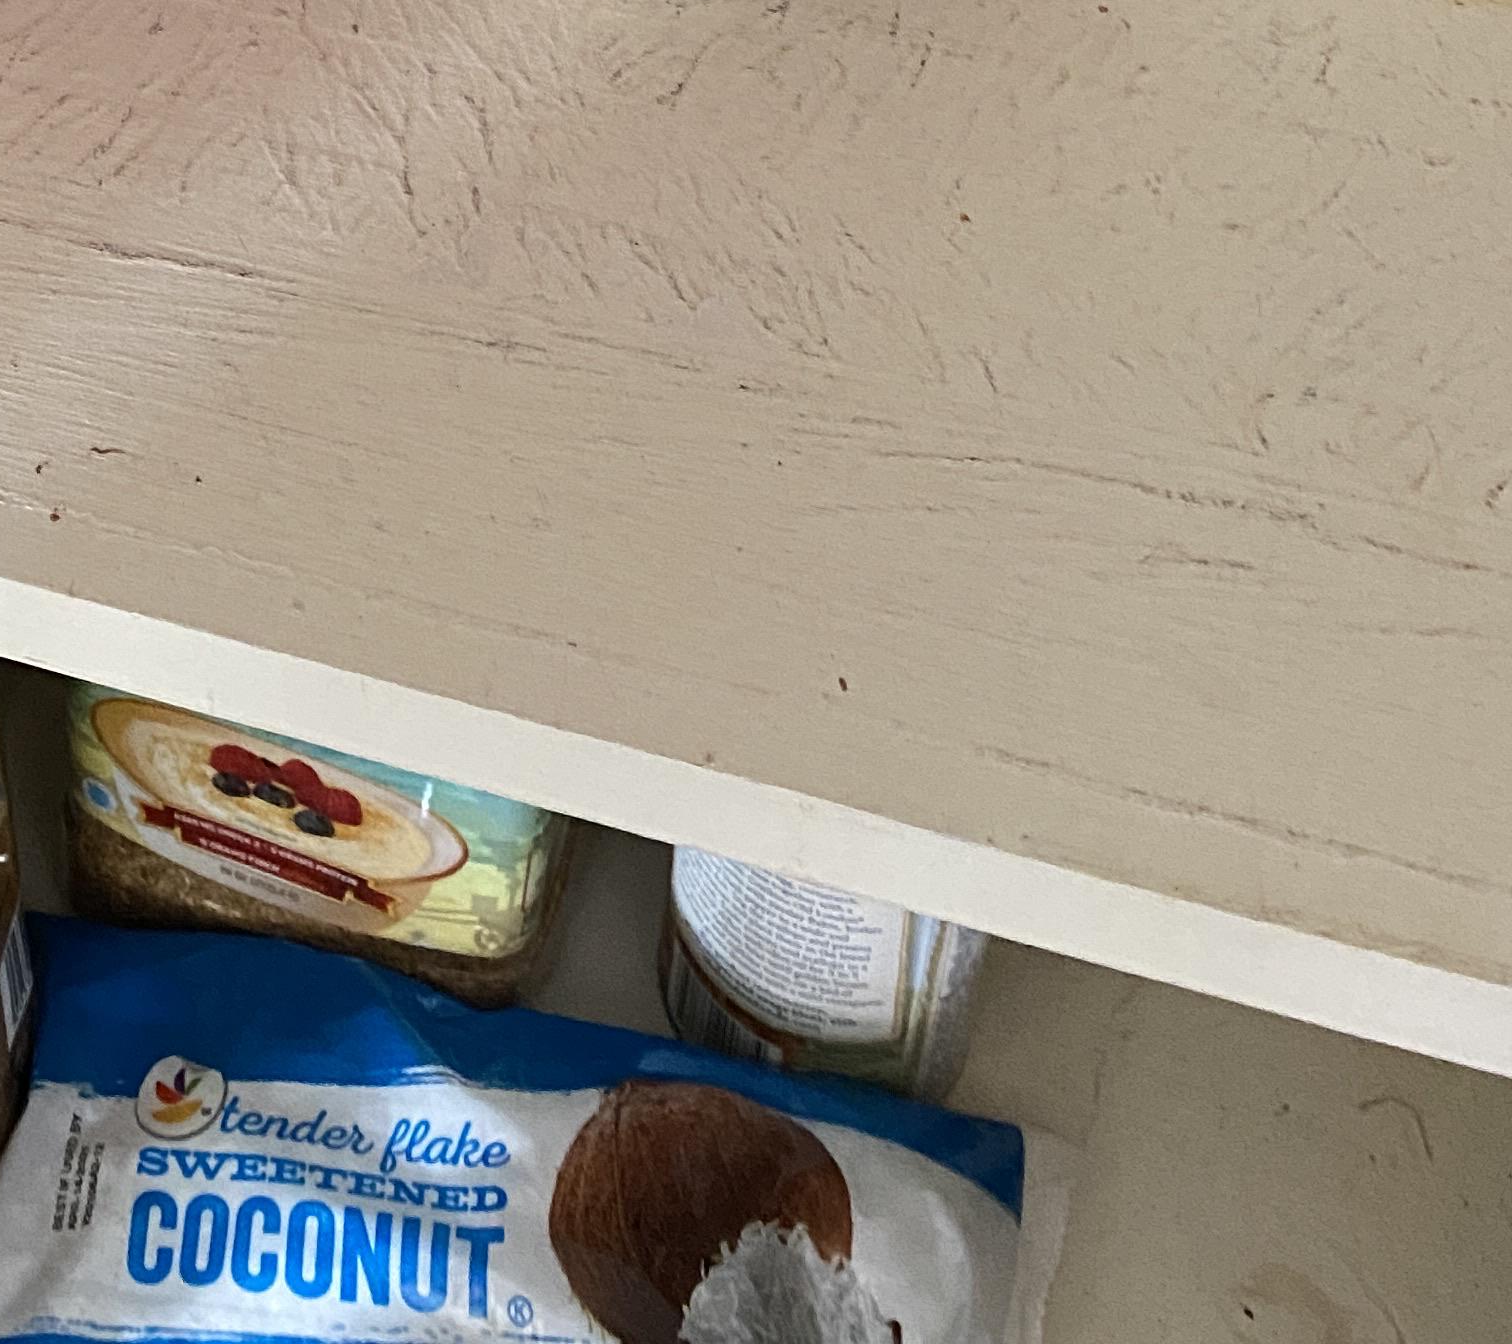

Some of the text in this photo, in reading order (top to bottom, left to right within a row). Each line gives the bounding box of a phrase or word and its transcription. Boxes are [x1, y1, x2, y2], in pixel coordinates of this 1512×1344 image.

[220, 1098, 511, 1174] tender flake
[136, 1145, 508, 1214] SWEETENED
[128, 1189, 504, 1319] COCONUT
